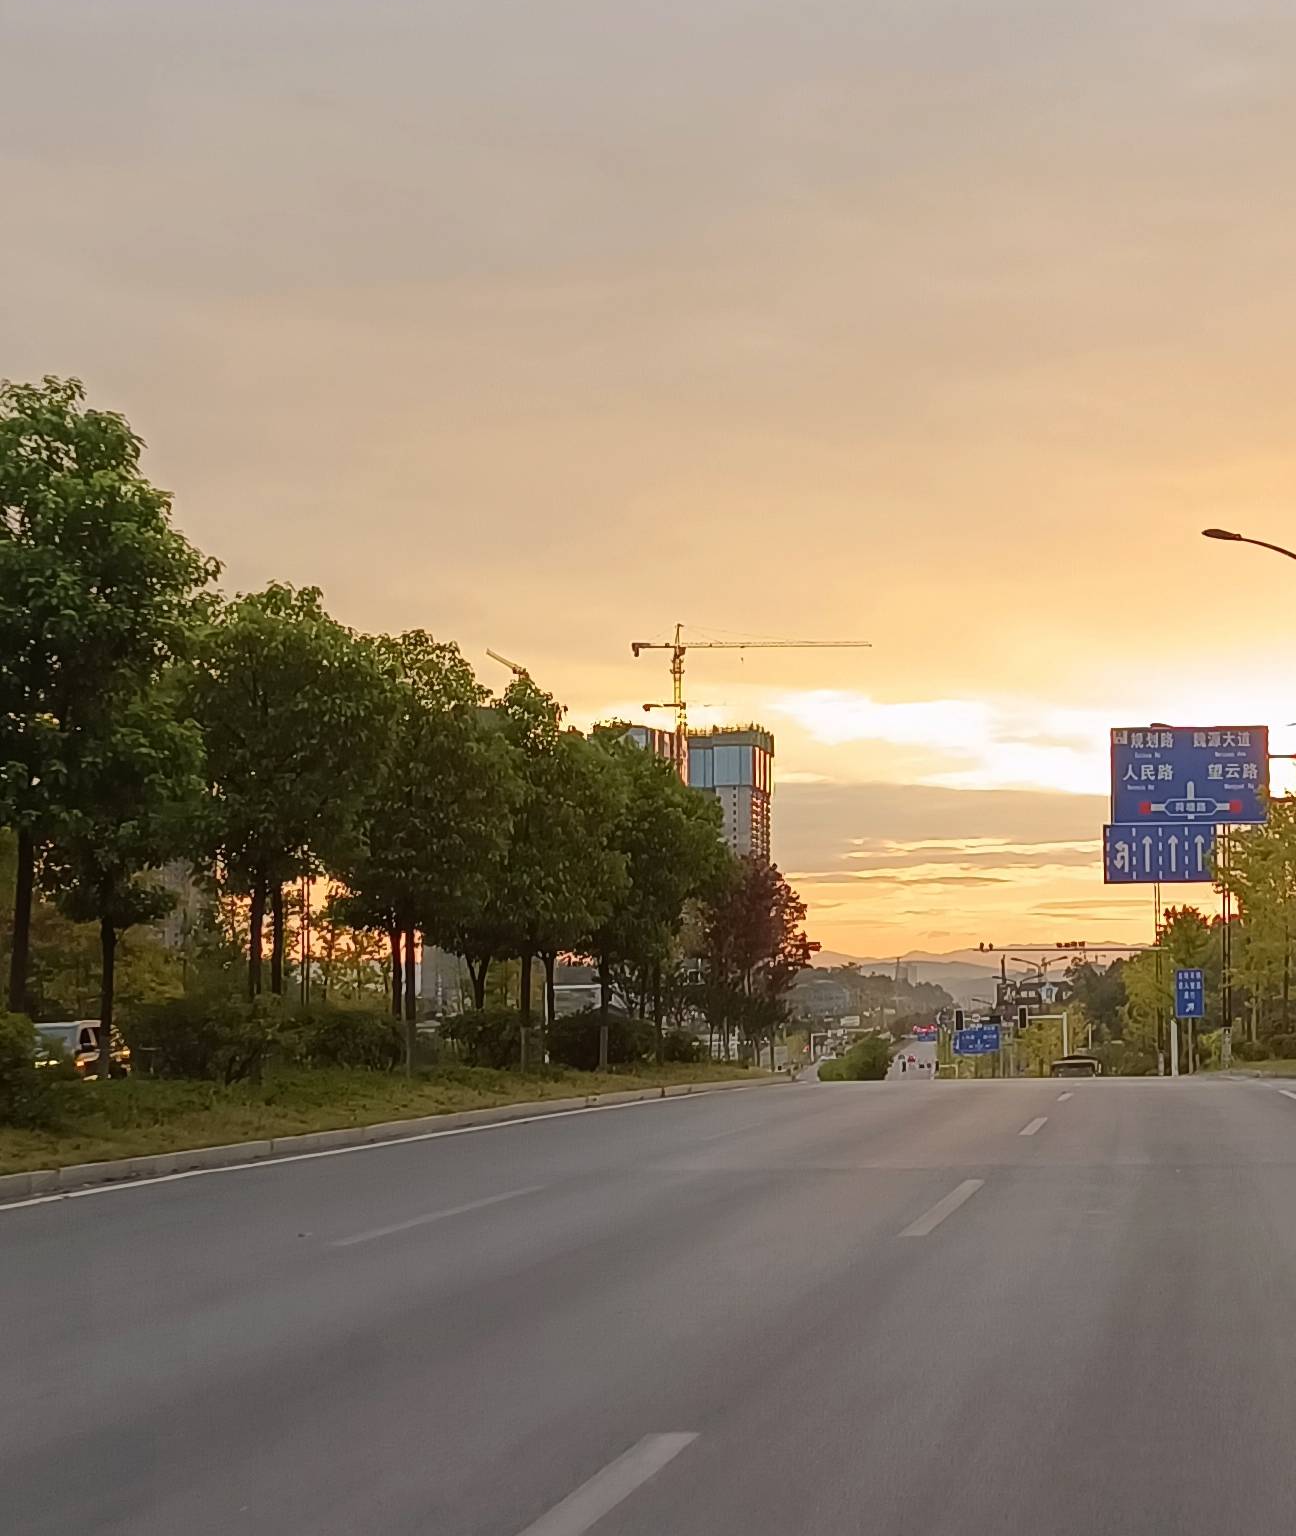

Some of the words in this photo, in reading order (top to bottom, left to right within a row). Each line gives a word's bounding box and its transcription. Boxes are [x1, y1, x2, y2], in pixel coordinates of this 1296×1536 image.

[1122, 764, 1173, 781] 人民路
[1208, 763, 1258, 780] 望云路
